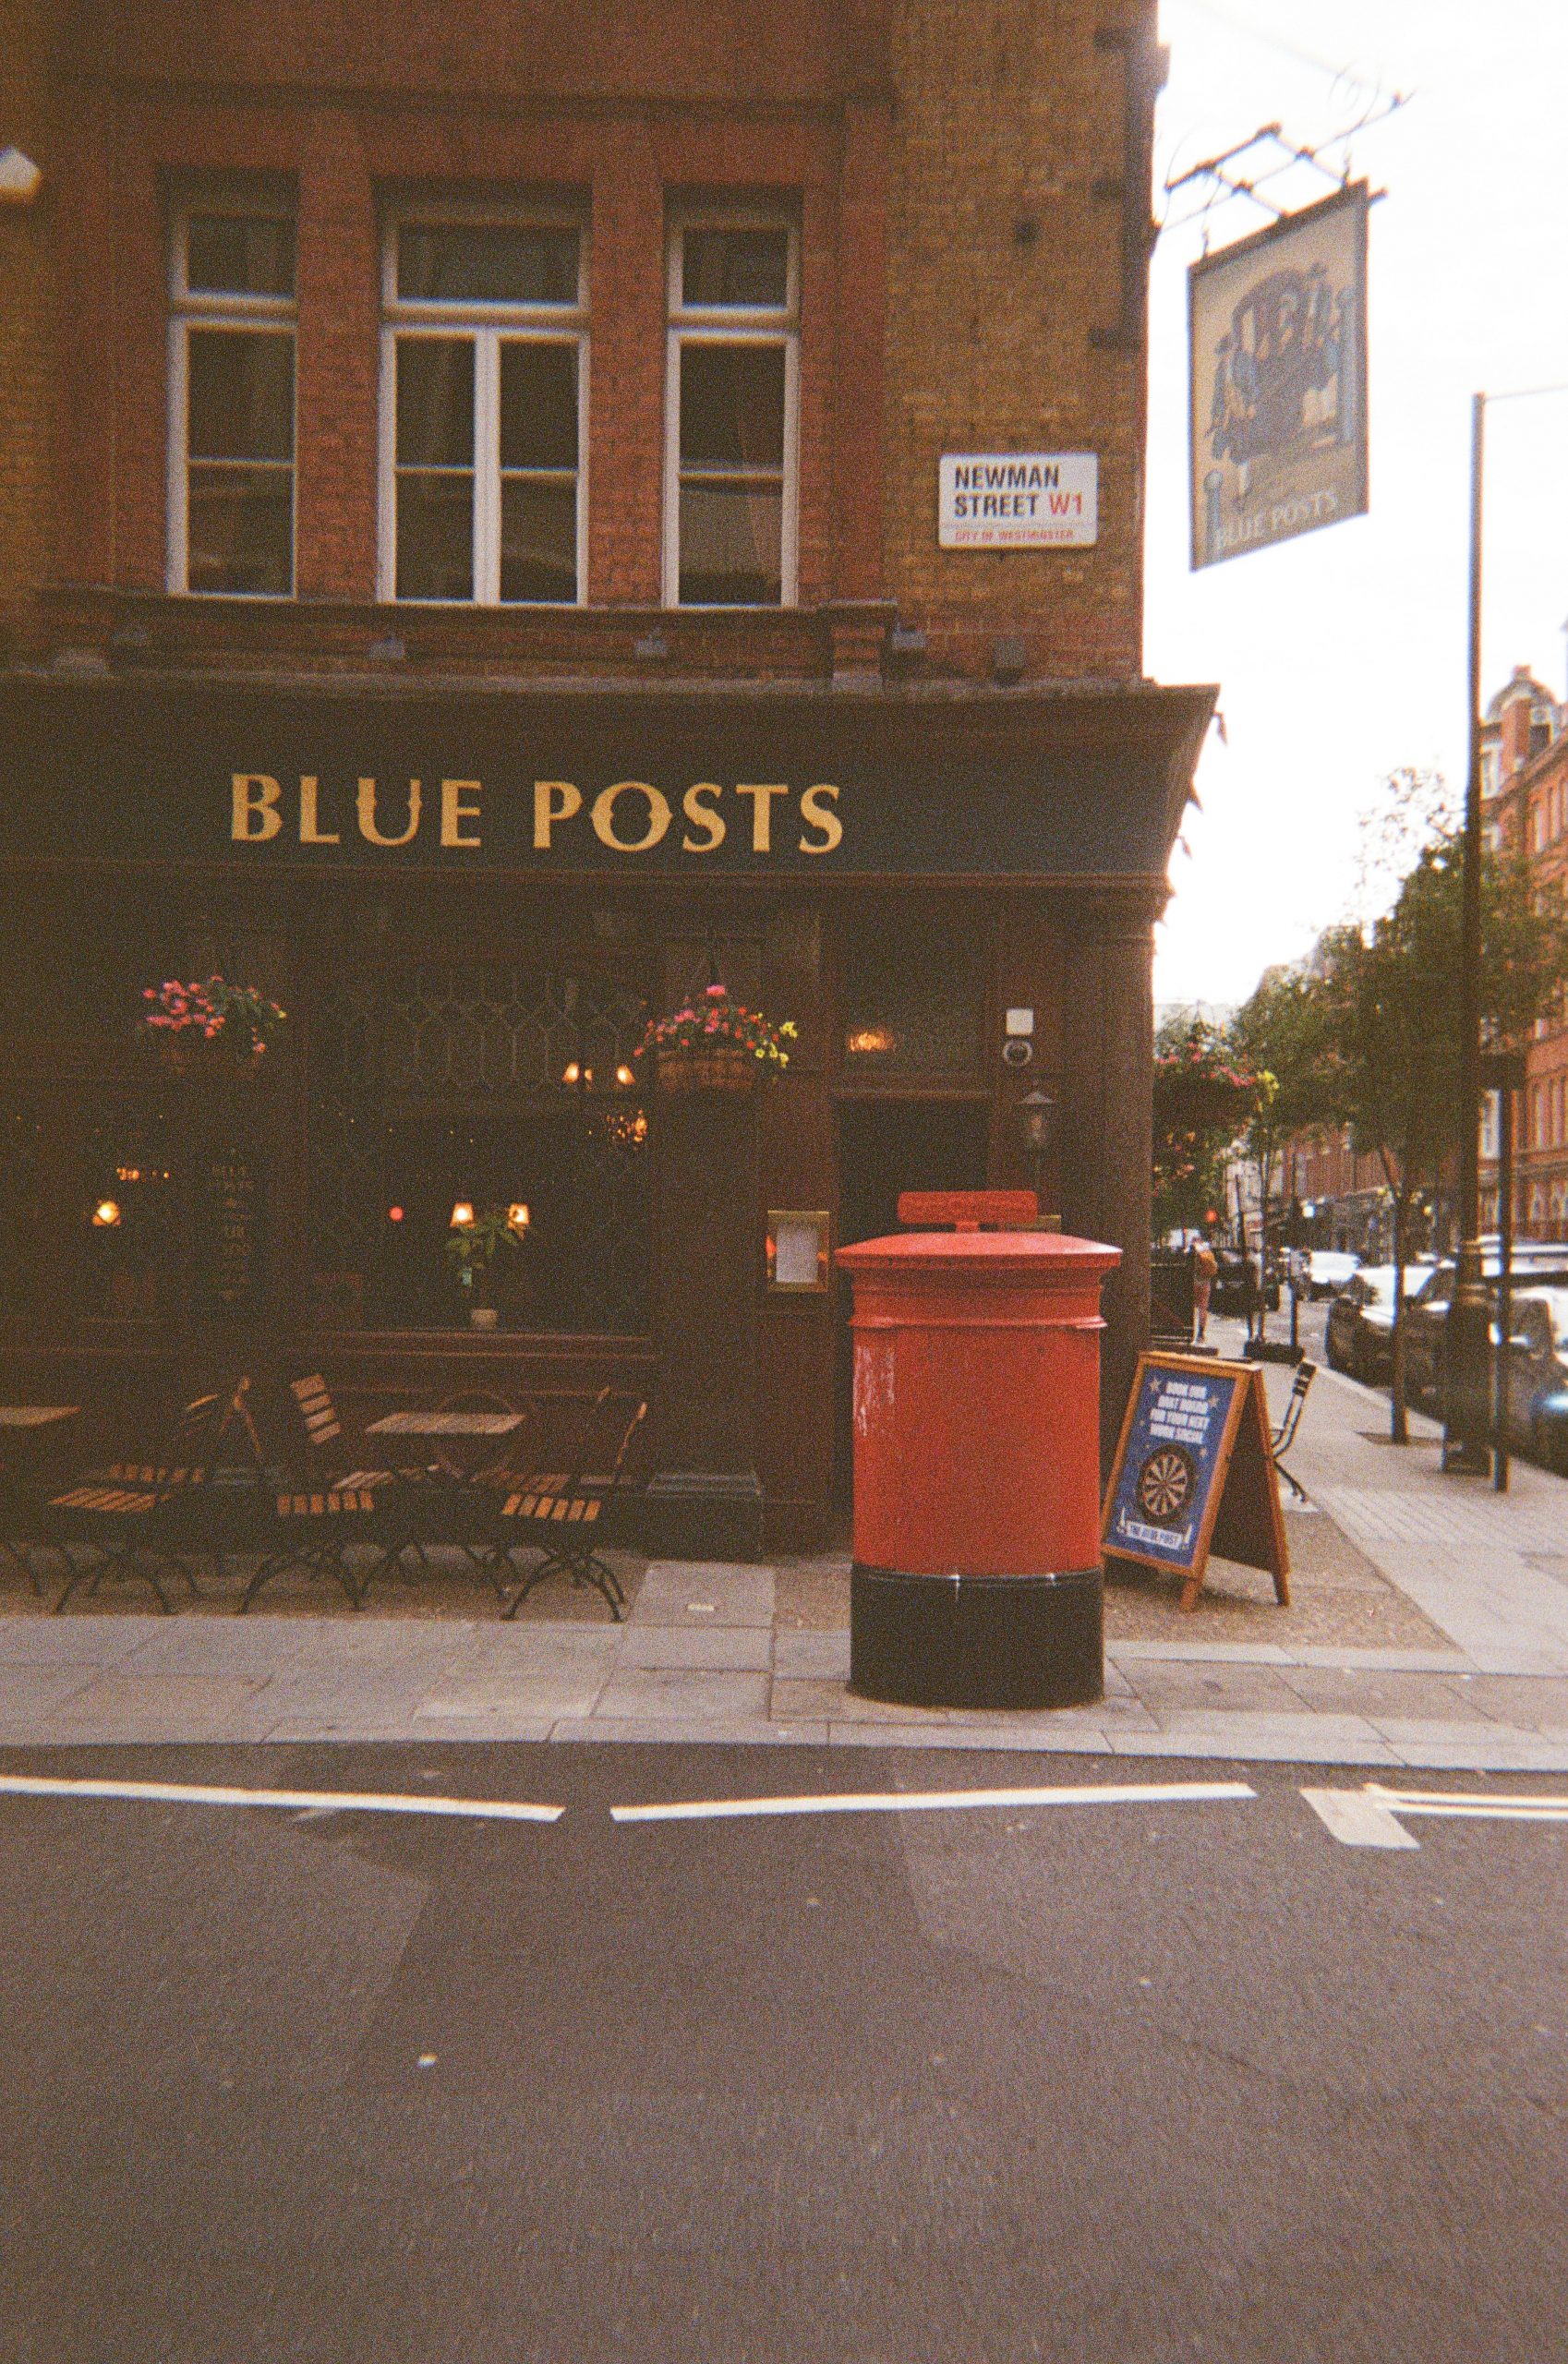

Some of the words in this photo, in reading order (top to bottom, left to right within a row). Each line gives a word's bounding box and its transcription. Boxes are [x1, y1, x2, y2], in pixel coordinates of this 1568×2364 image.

[955, 464, 1059, 488] NEWMAN
[955, 494, 1038, 517] STREET
[1049, 492, 1082, 515] W1
[1272, 490, 1339, 530] POSTS
[955, 531, 978, 541] CITY
[982, 530, 994, 540] OF
[999, 529, 1074, 540] WESTMINSTER
[230, 773, 481, 847] BLUE
[534, 780, 842, 852] POSTS
